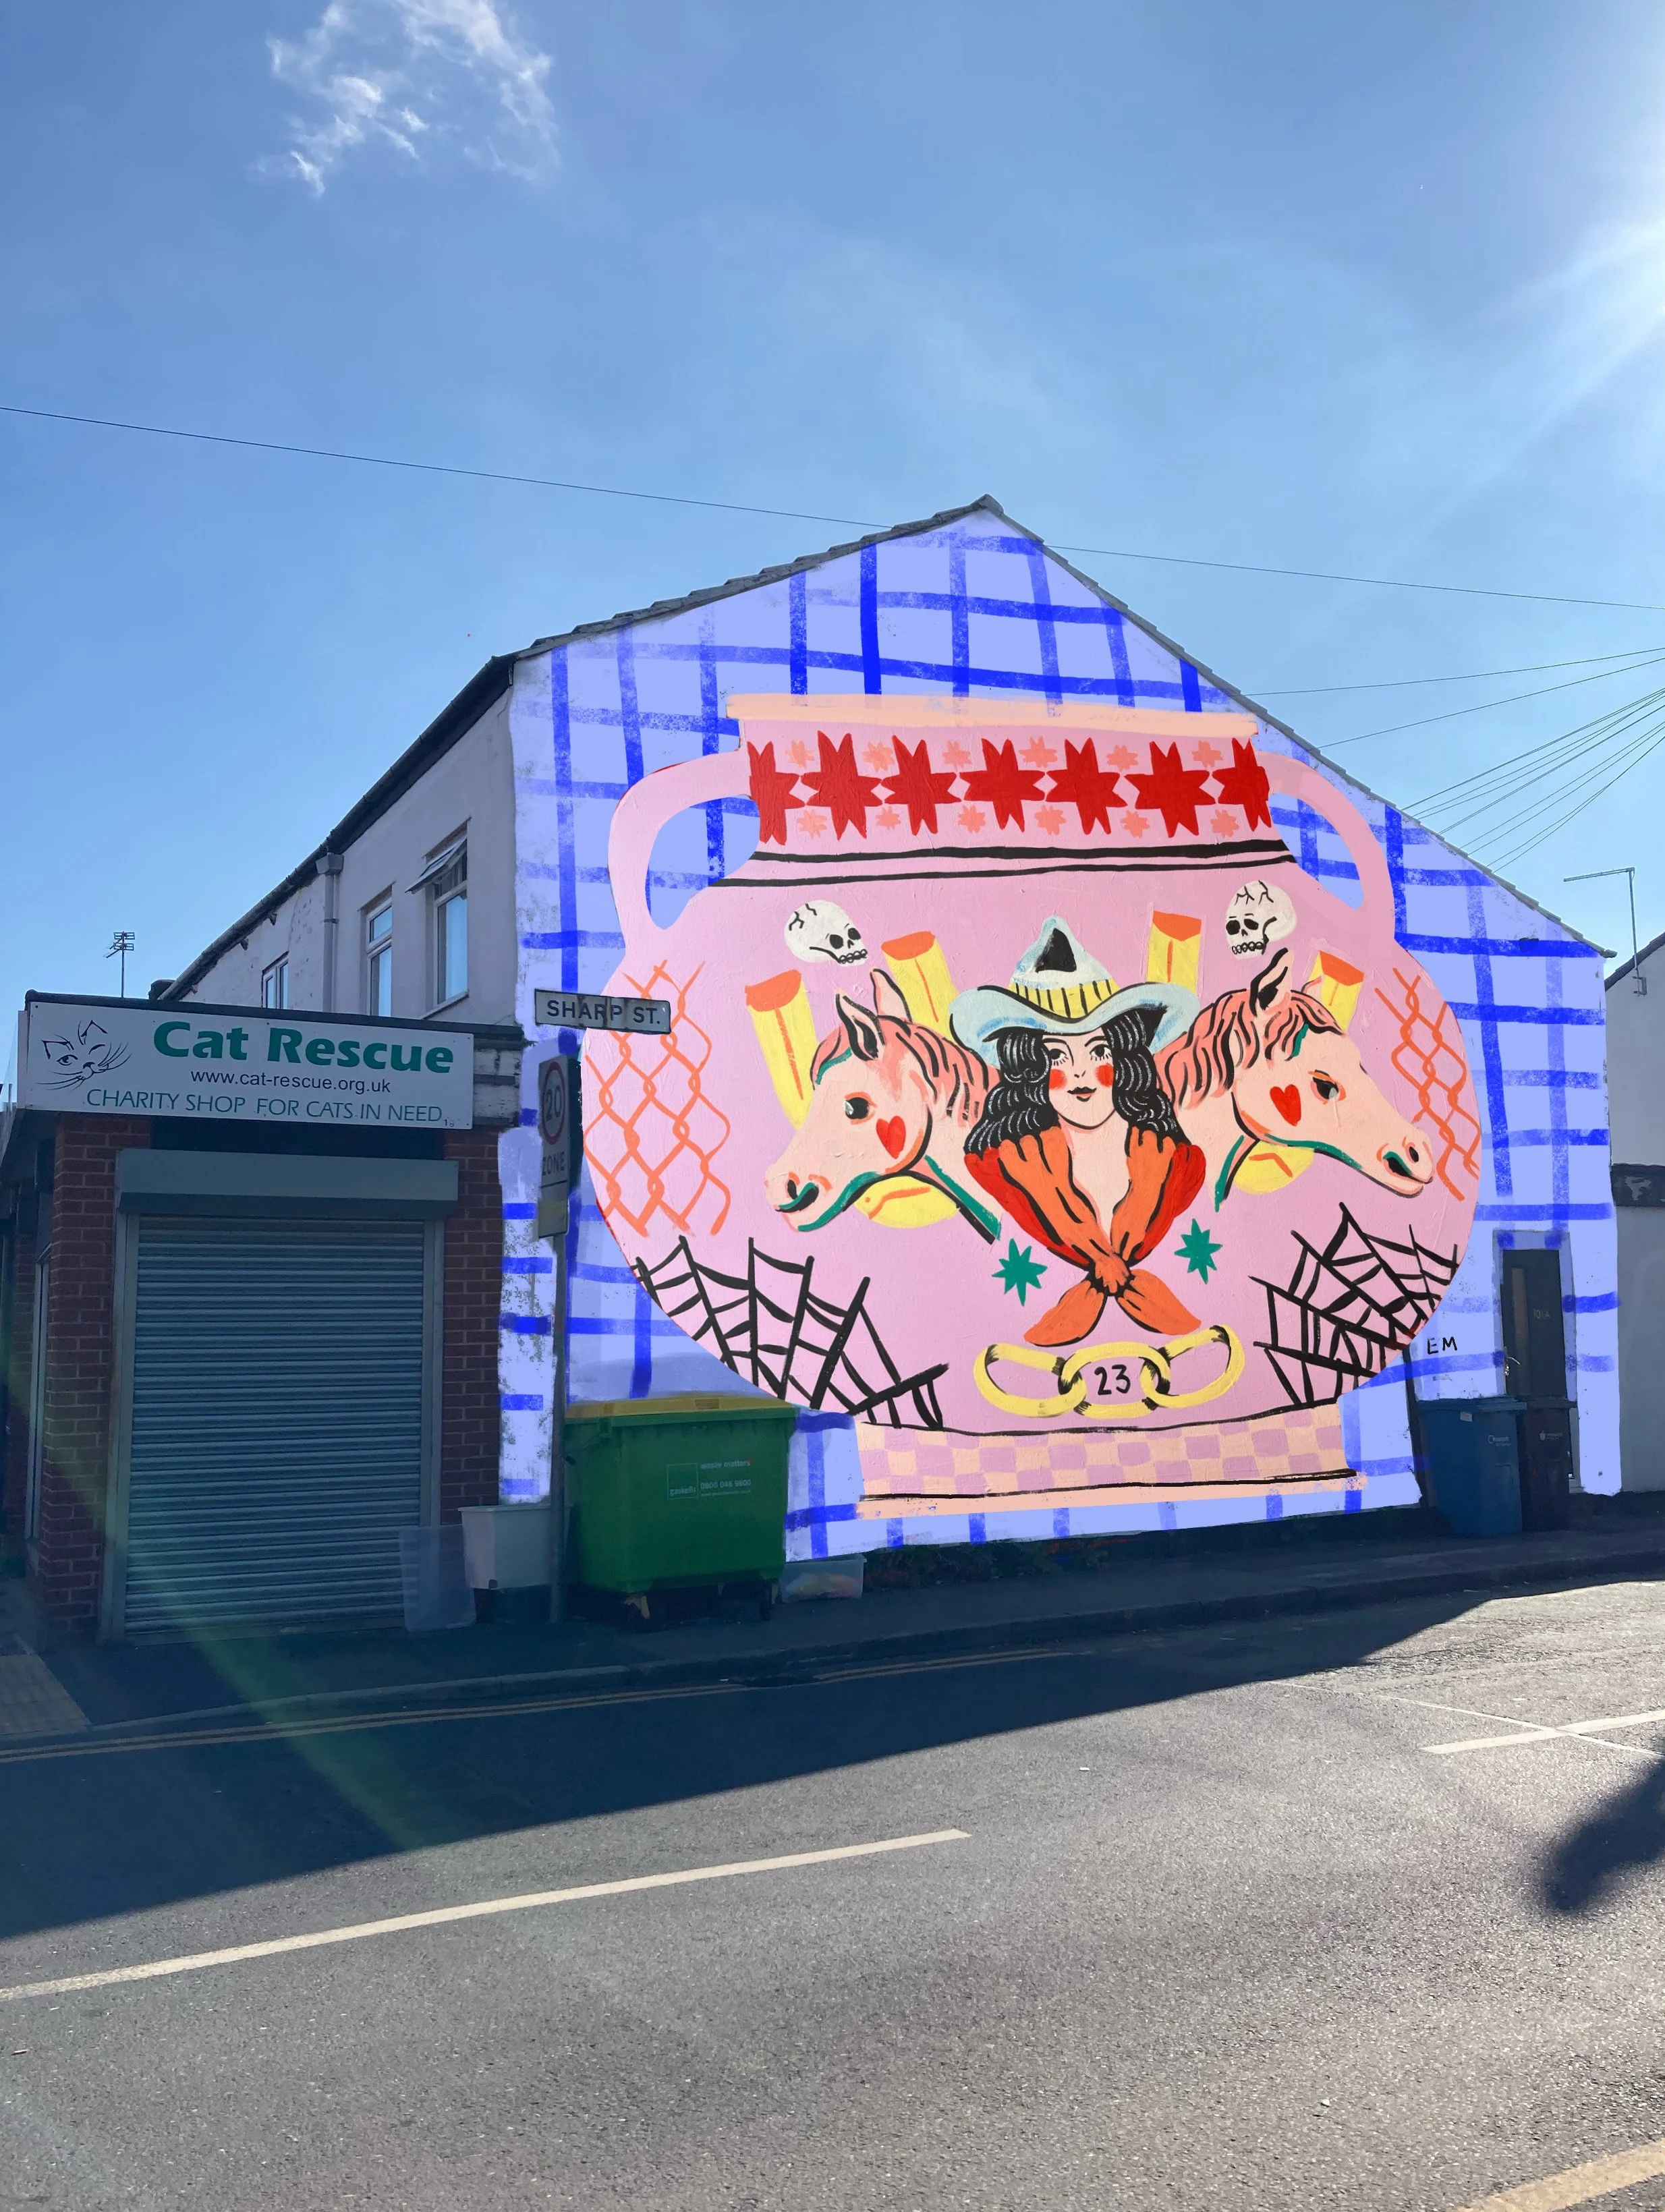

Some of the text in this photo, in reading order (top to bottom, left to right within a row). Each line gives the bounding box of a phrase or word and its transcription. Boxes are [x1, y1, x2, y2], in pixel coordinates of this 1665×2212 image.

[546, 999, 661, 1025] SHARP ST.
[154, 1021, 454, 1073] Cat Rescue
[190, 1071, 391, 1095] www.cat-rescue.org.uk
[86, 1089, 442, 1122] CHARITY SHOP FOR CATS IN NEED
[545, 1085, 563, 1122] 20
[542, 1150, 565, 1176] ZONE
[1427, 1336, 1458, 1355] EM
[1094, 1363, 1131, 1396] 23
[700, 1460, 751, 1470] waste matters
[669, 1485, 696, 1496] gaskells
[700, 1481, 718, 1490] 0800
